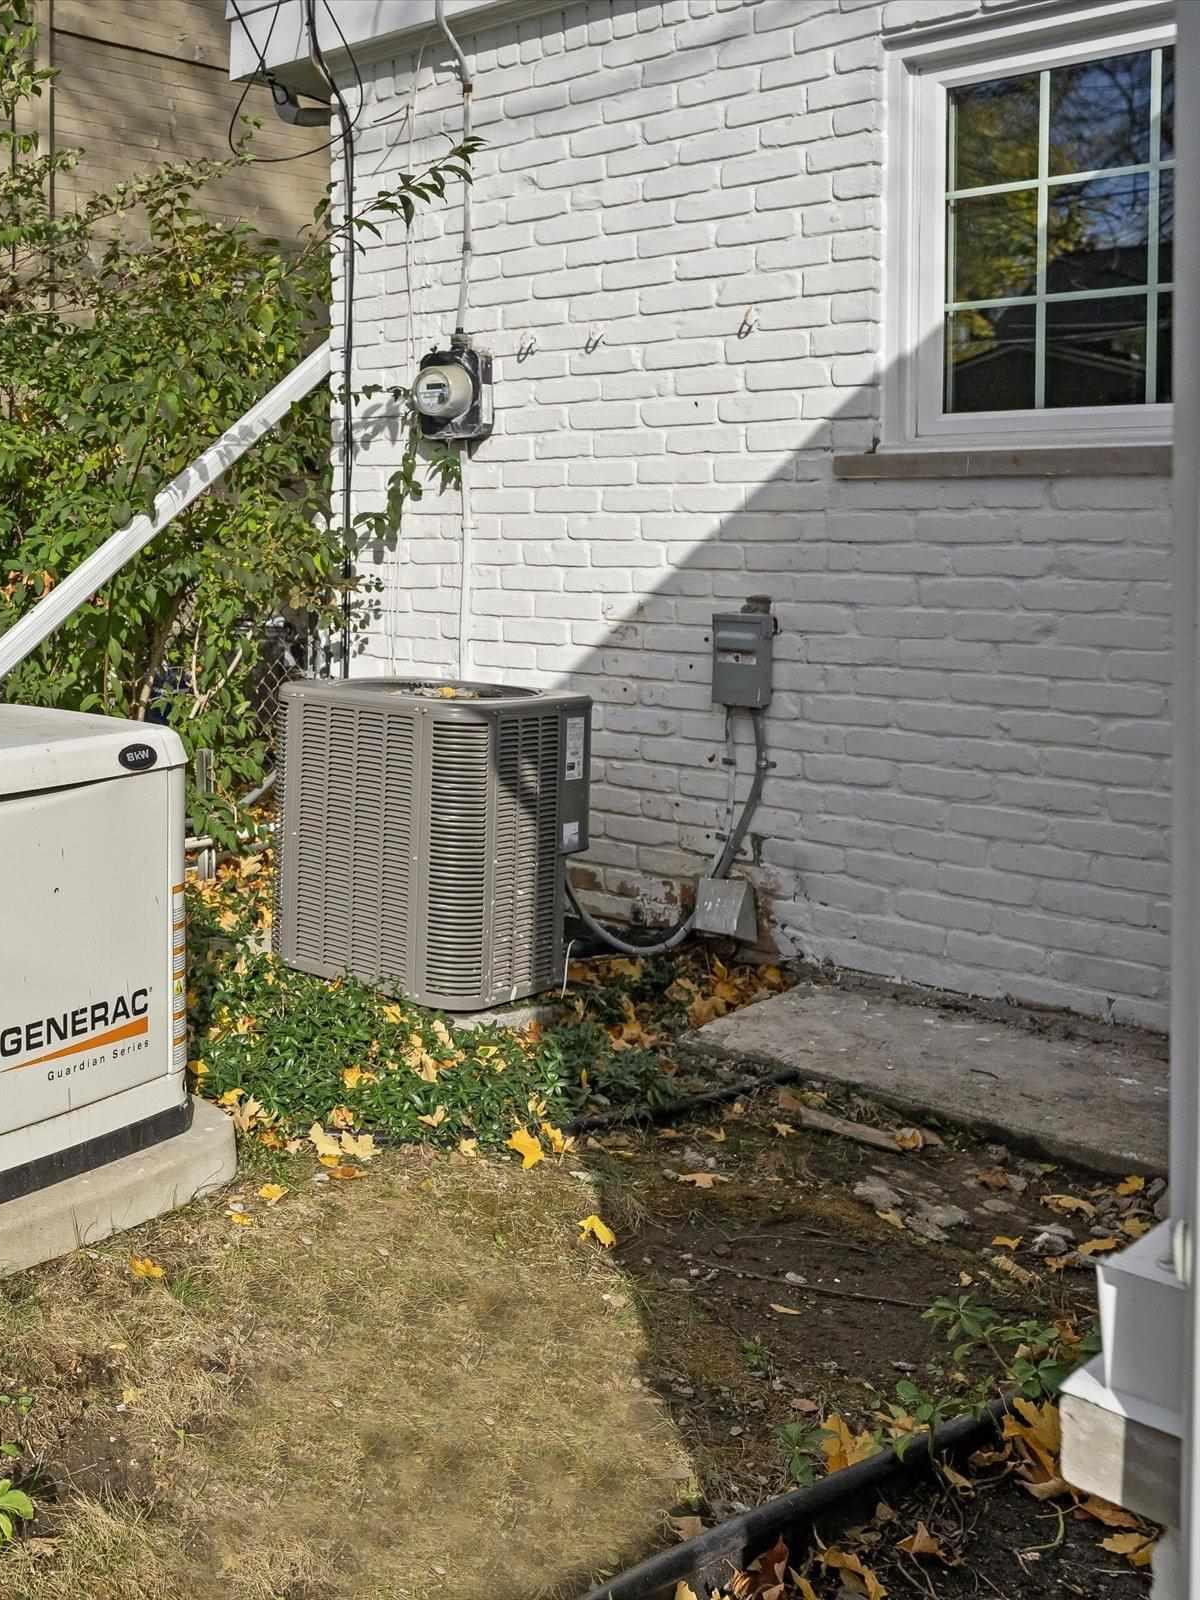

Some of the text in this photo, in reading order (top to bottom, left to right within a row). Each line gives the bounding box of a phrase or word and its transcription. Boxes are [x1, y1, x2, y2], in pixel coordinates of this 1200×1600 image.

[0, 988, 149, 1057] GENERAC
[47, 1040, 151, 1081] Guardian Series
